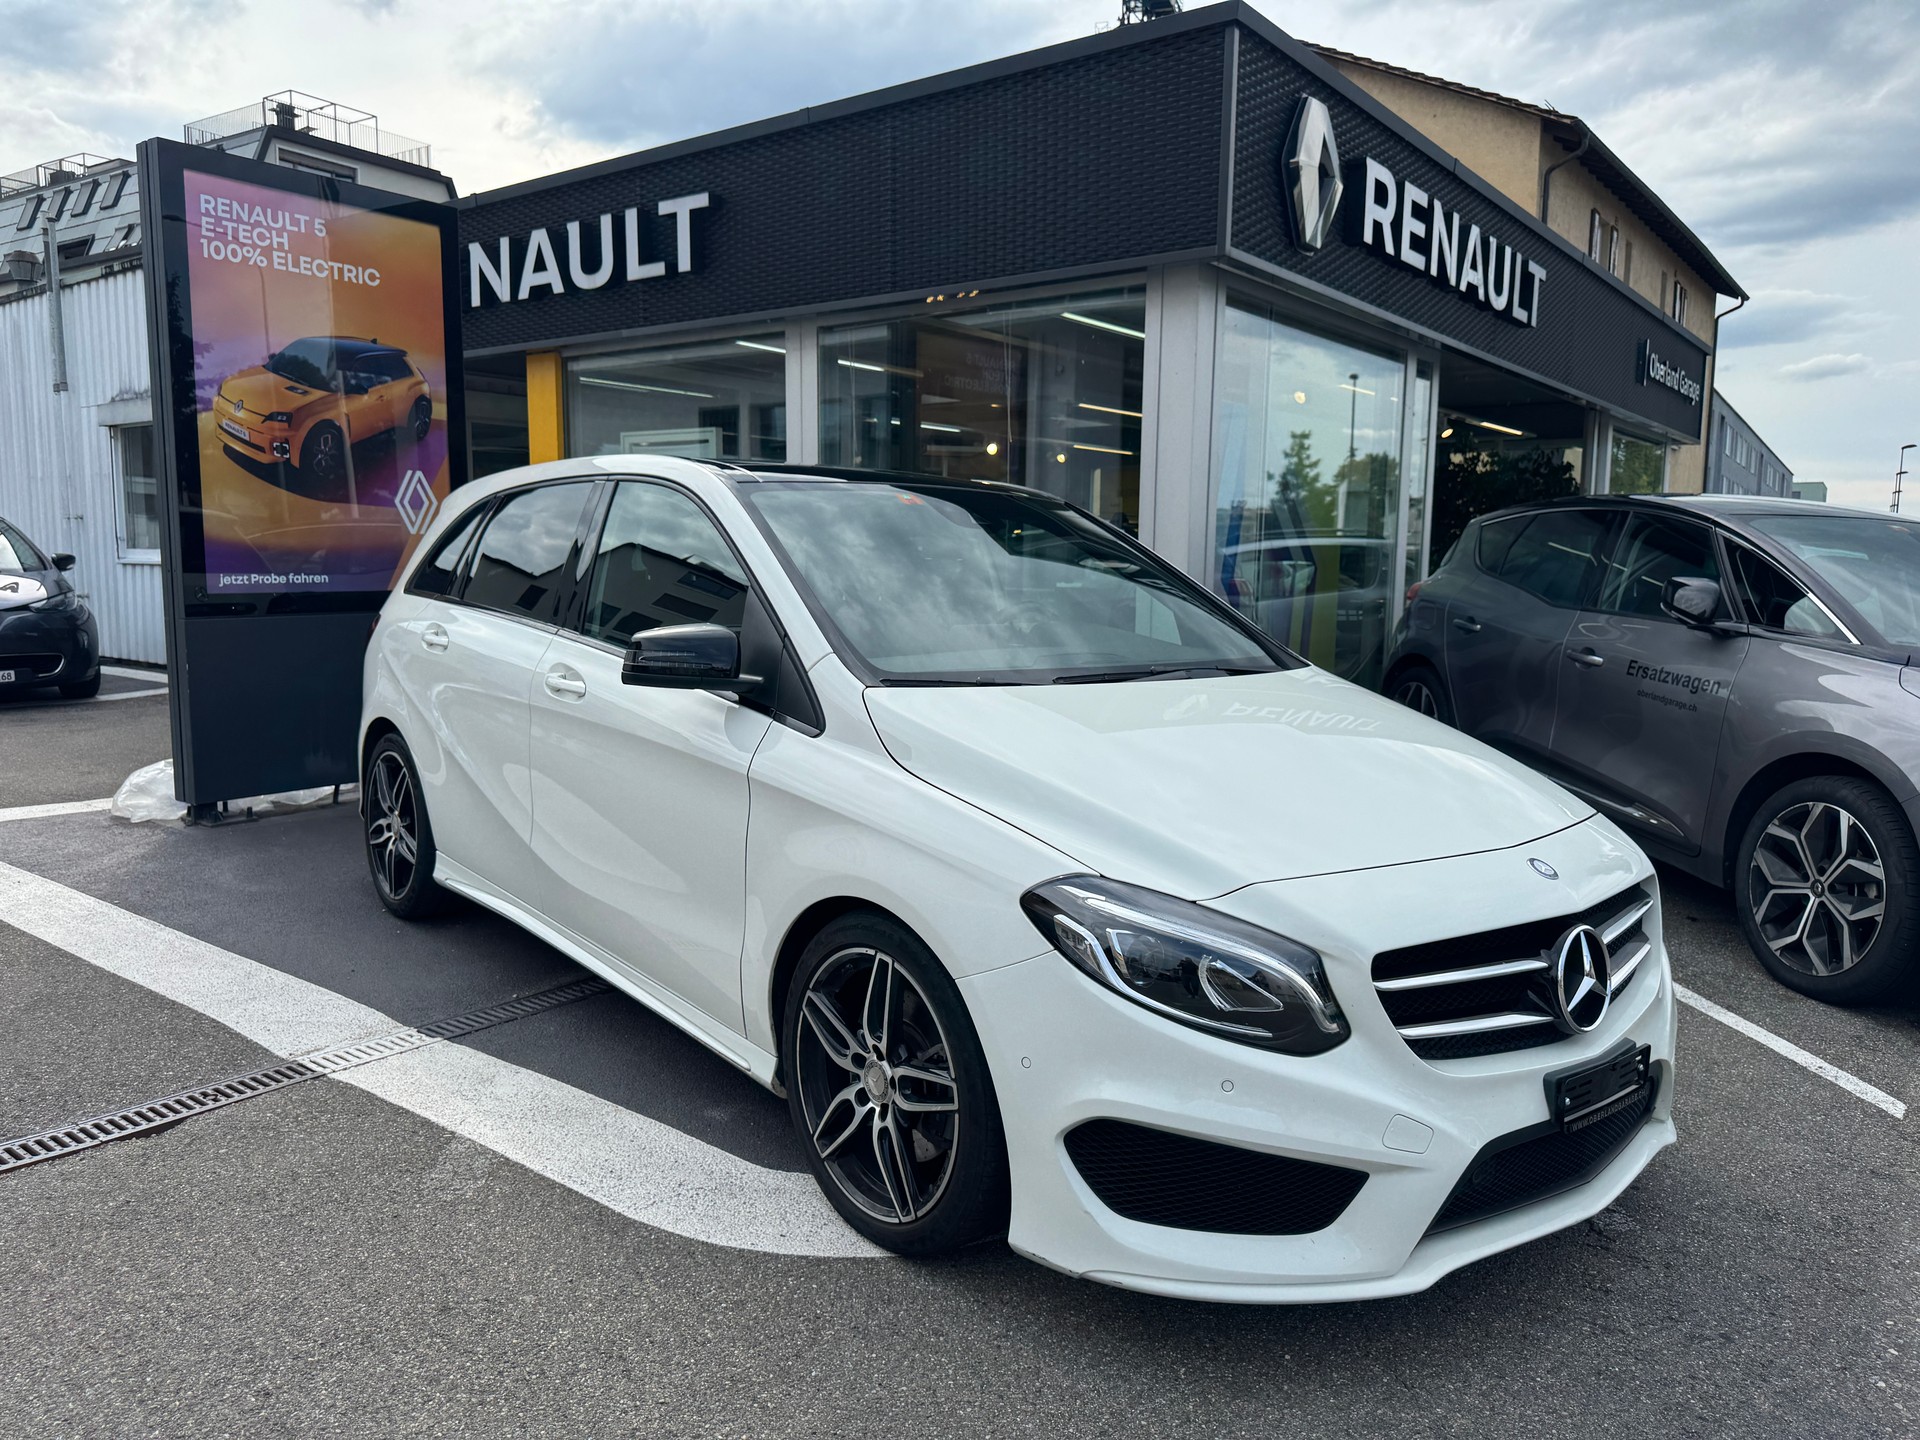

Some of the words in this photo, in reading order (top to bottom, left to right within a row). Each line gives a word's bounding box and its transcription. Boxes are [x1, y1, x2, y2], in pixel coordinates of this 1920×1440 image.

[199, 193, 310, 234] RENAULT
[314, 219, 328, 238] 5
[200, 216, 289, 250] E-TECH
[200, 238, 268, 269] 100%
[273, 250, 381, 287] ELECTRIC
[468, 192, 710, 308] NAULT
[1363, 156, 1547, 328] RENAULT
[1649, 352, 1680, 391] Oberland
[1679, 370, 1700, 406] Garage
[219, 573, 249, 587] jetzt
[251, 573, 287, 584] Probe
[289, 572, 329, 584] fahren
[1626, 659, 1721, 695] Ersatzwagen
[1636, 688, 1698, 713] oberlandgarage.ch
